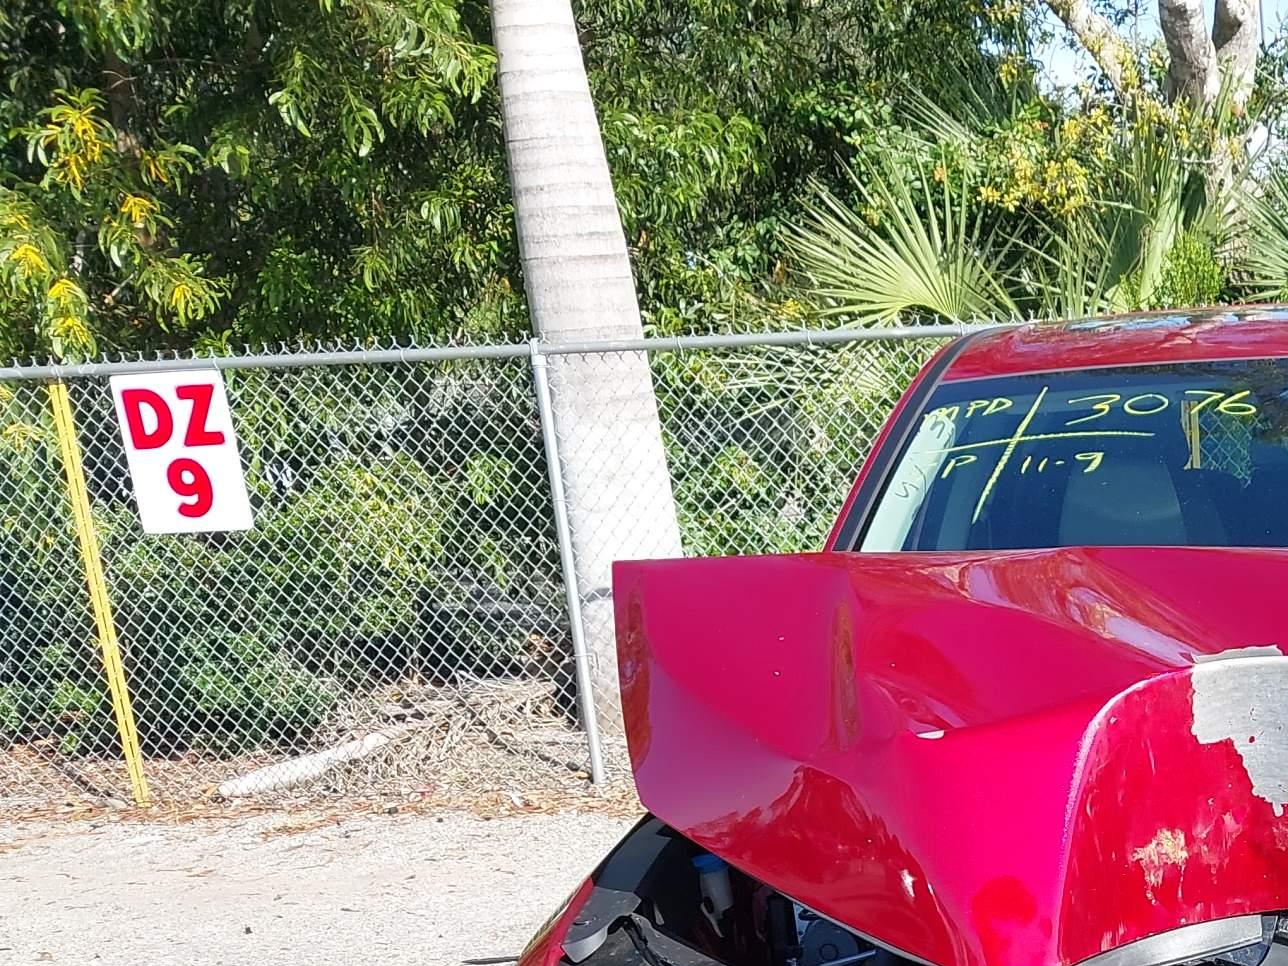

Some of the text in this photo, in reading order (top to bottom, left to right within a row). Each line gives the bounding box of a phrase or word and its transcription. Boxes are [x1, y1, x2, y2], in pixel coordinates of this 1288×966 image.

[121, 384, 226, 450] DZ
[1065, 390, 1257, 426] 3076
[167, 458, 214, 518] 9
